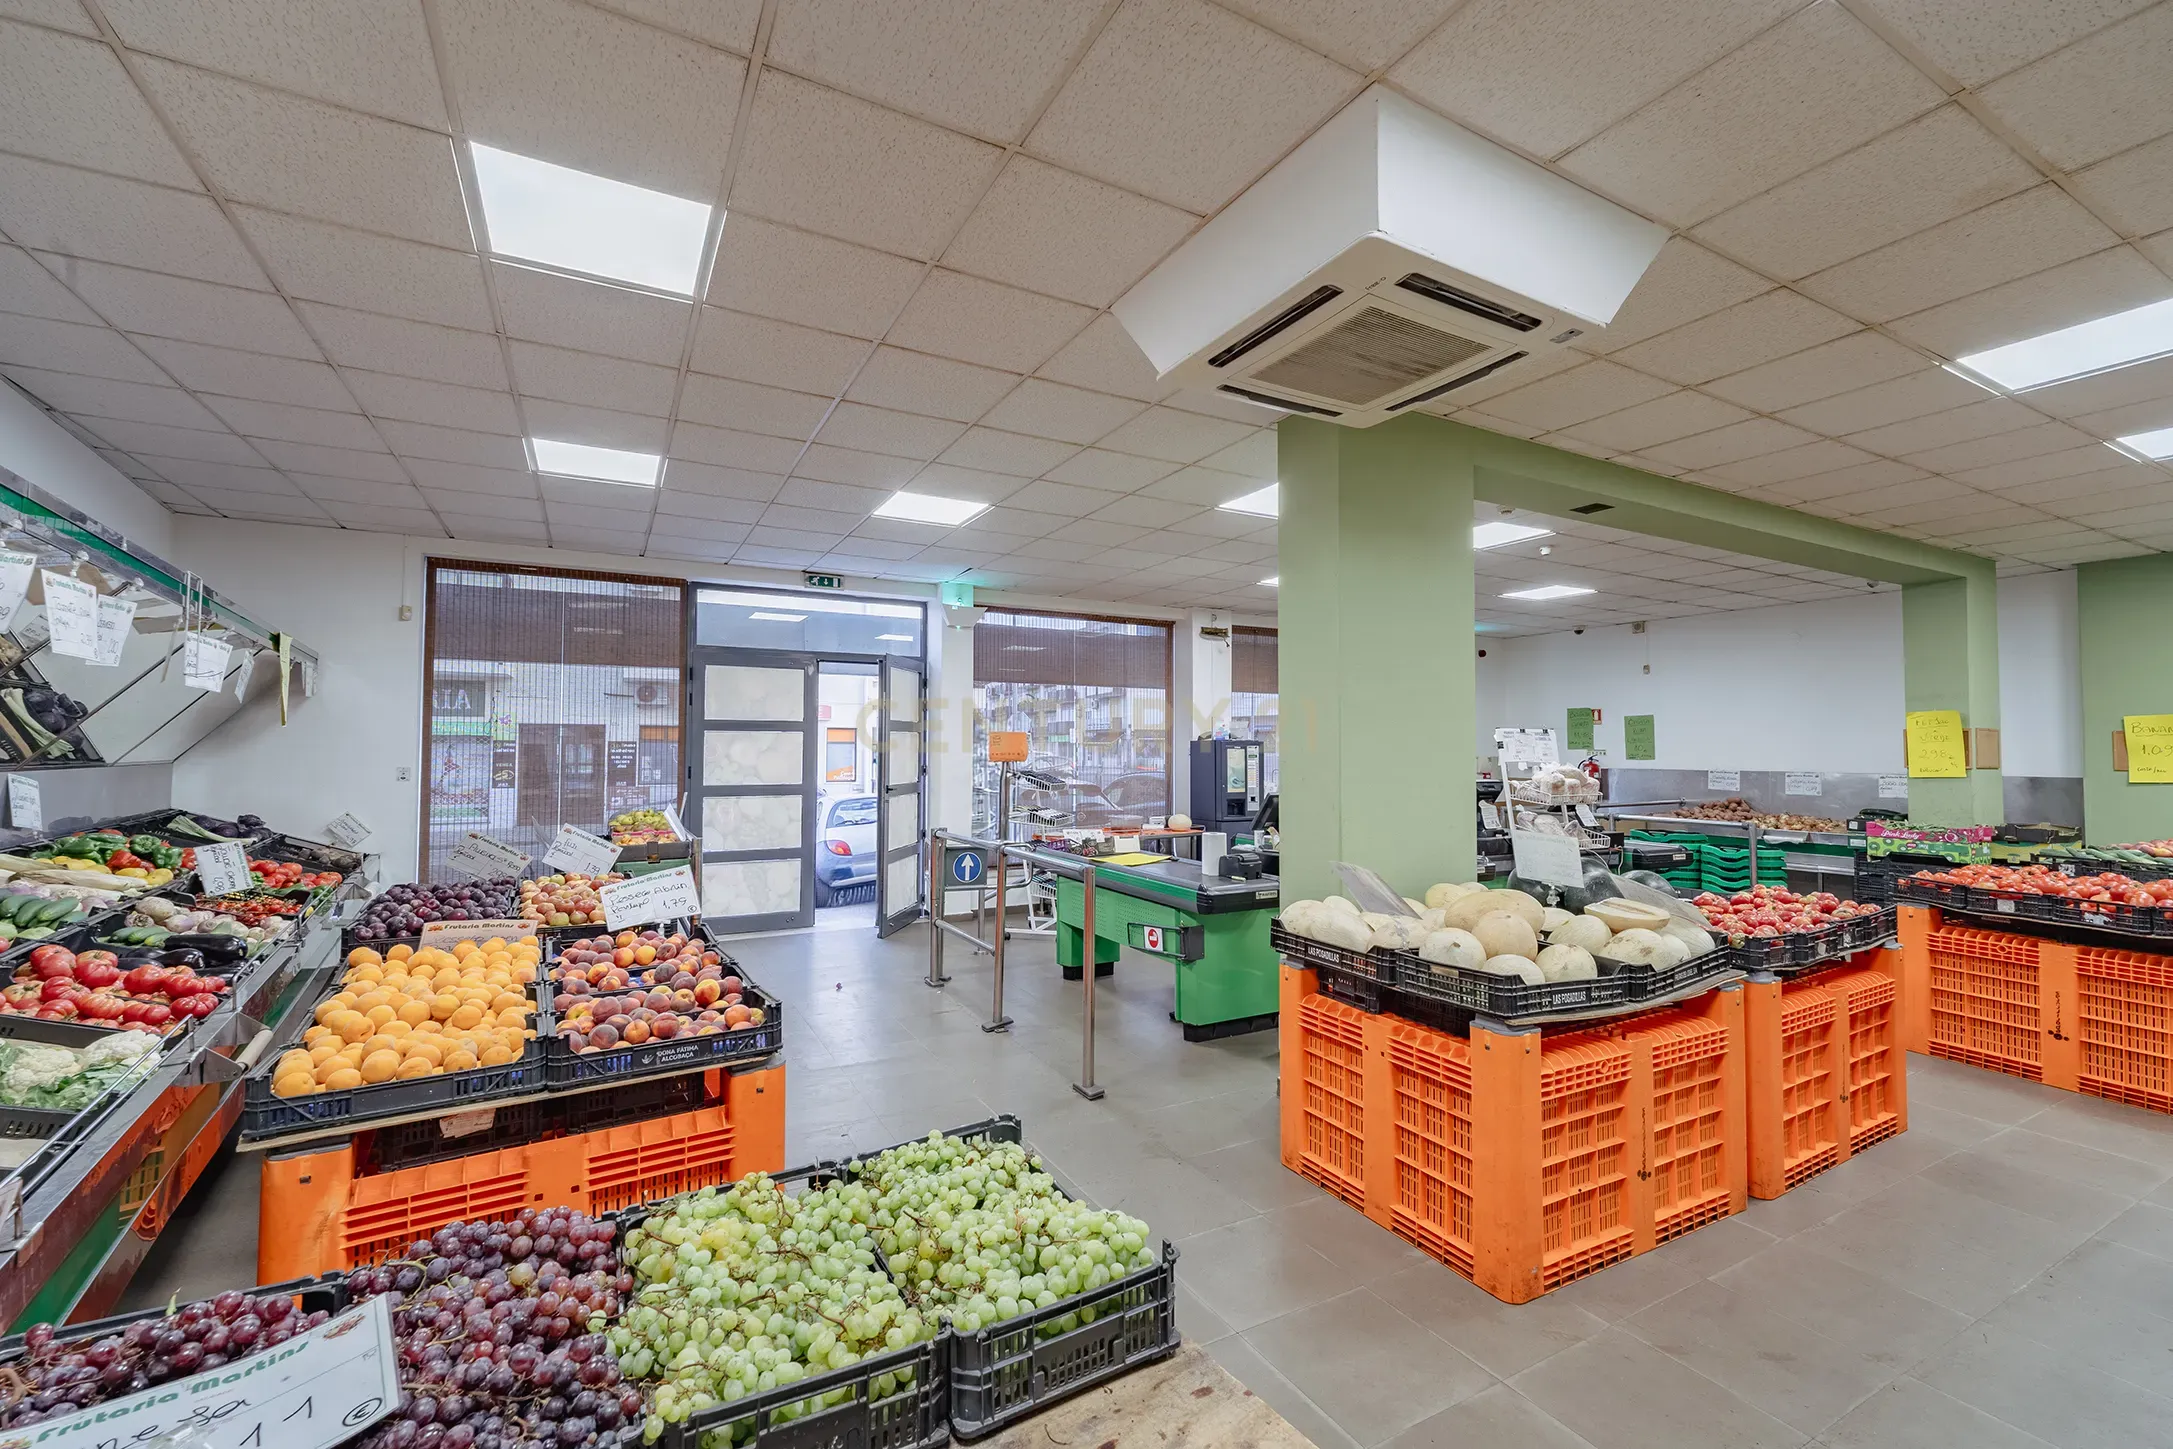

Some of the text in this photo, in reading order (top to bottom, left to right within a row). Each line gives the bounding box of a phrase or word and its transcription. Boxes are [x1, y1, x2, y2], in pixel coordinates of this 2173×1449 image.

[1881, 829, 1920, 839] Pink Lady
[616, 872, 672, 891] Frutaria Martins
[444, 922, 514, 931] Frutaria Martins
[657, 1044, 699, 1057] DONA FÁTIMA
[661, 1051, 695, 1062] ALCOBAÇA
[36, 1341, 310, 1443] Frutaria Martins
